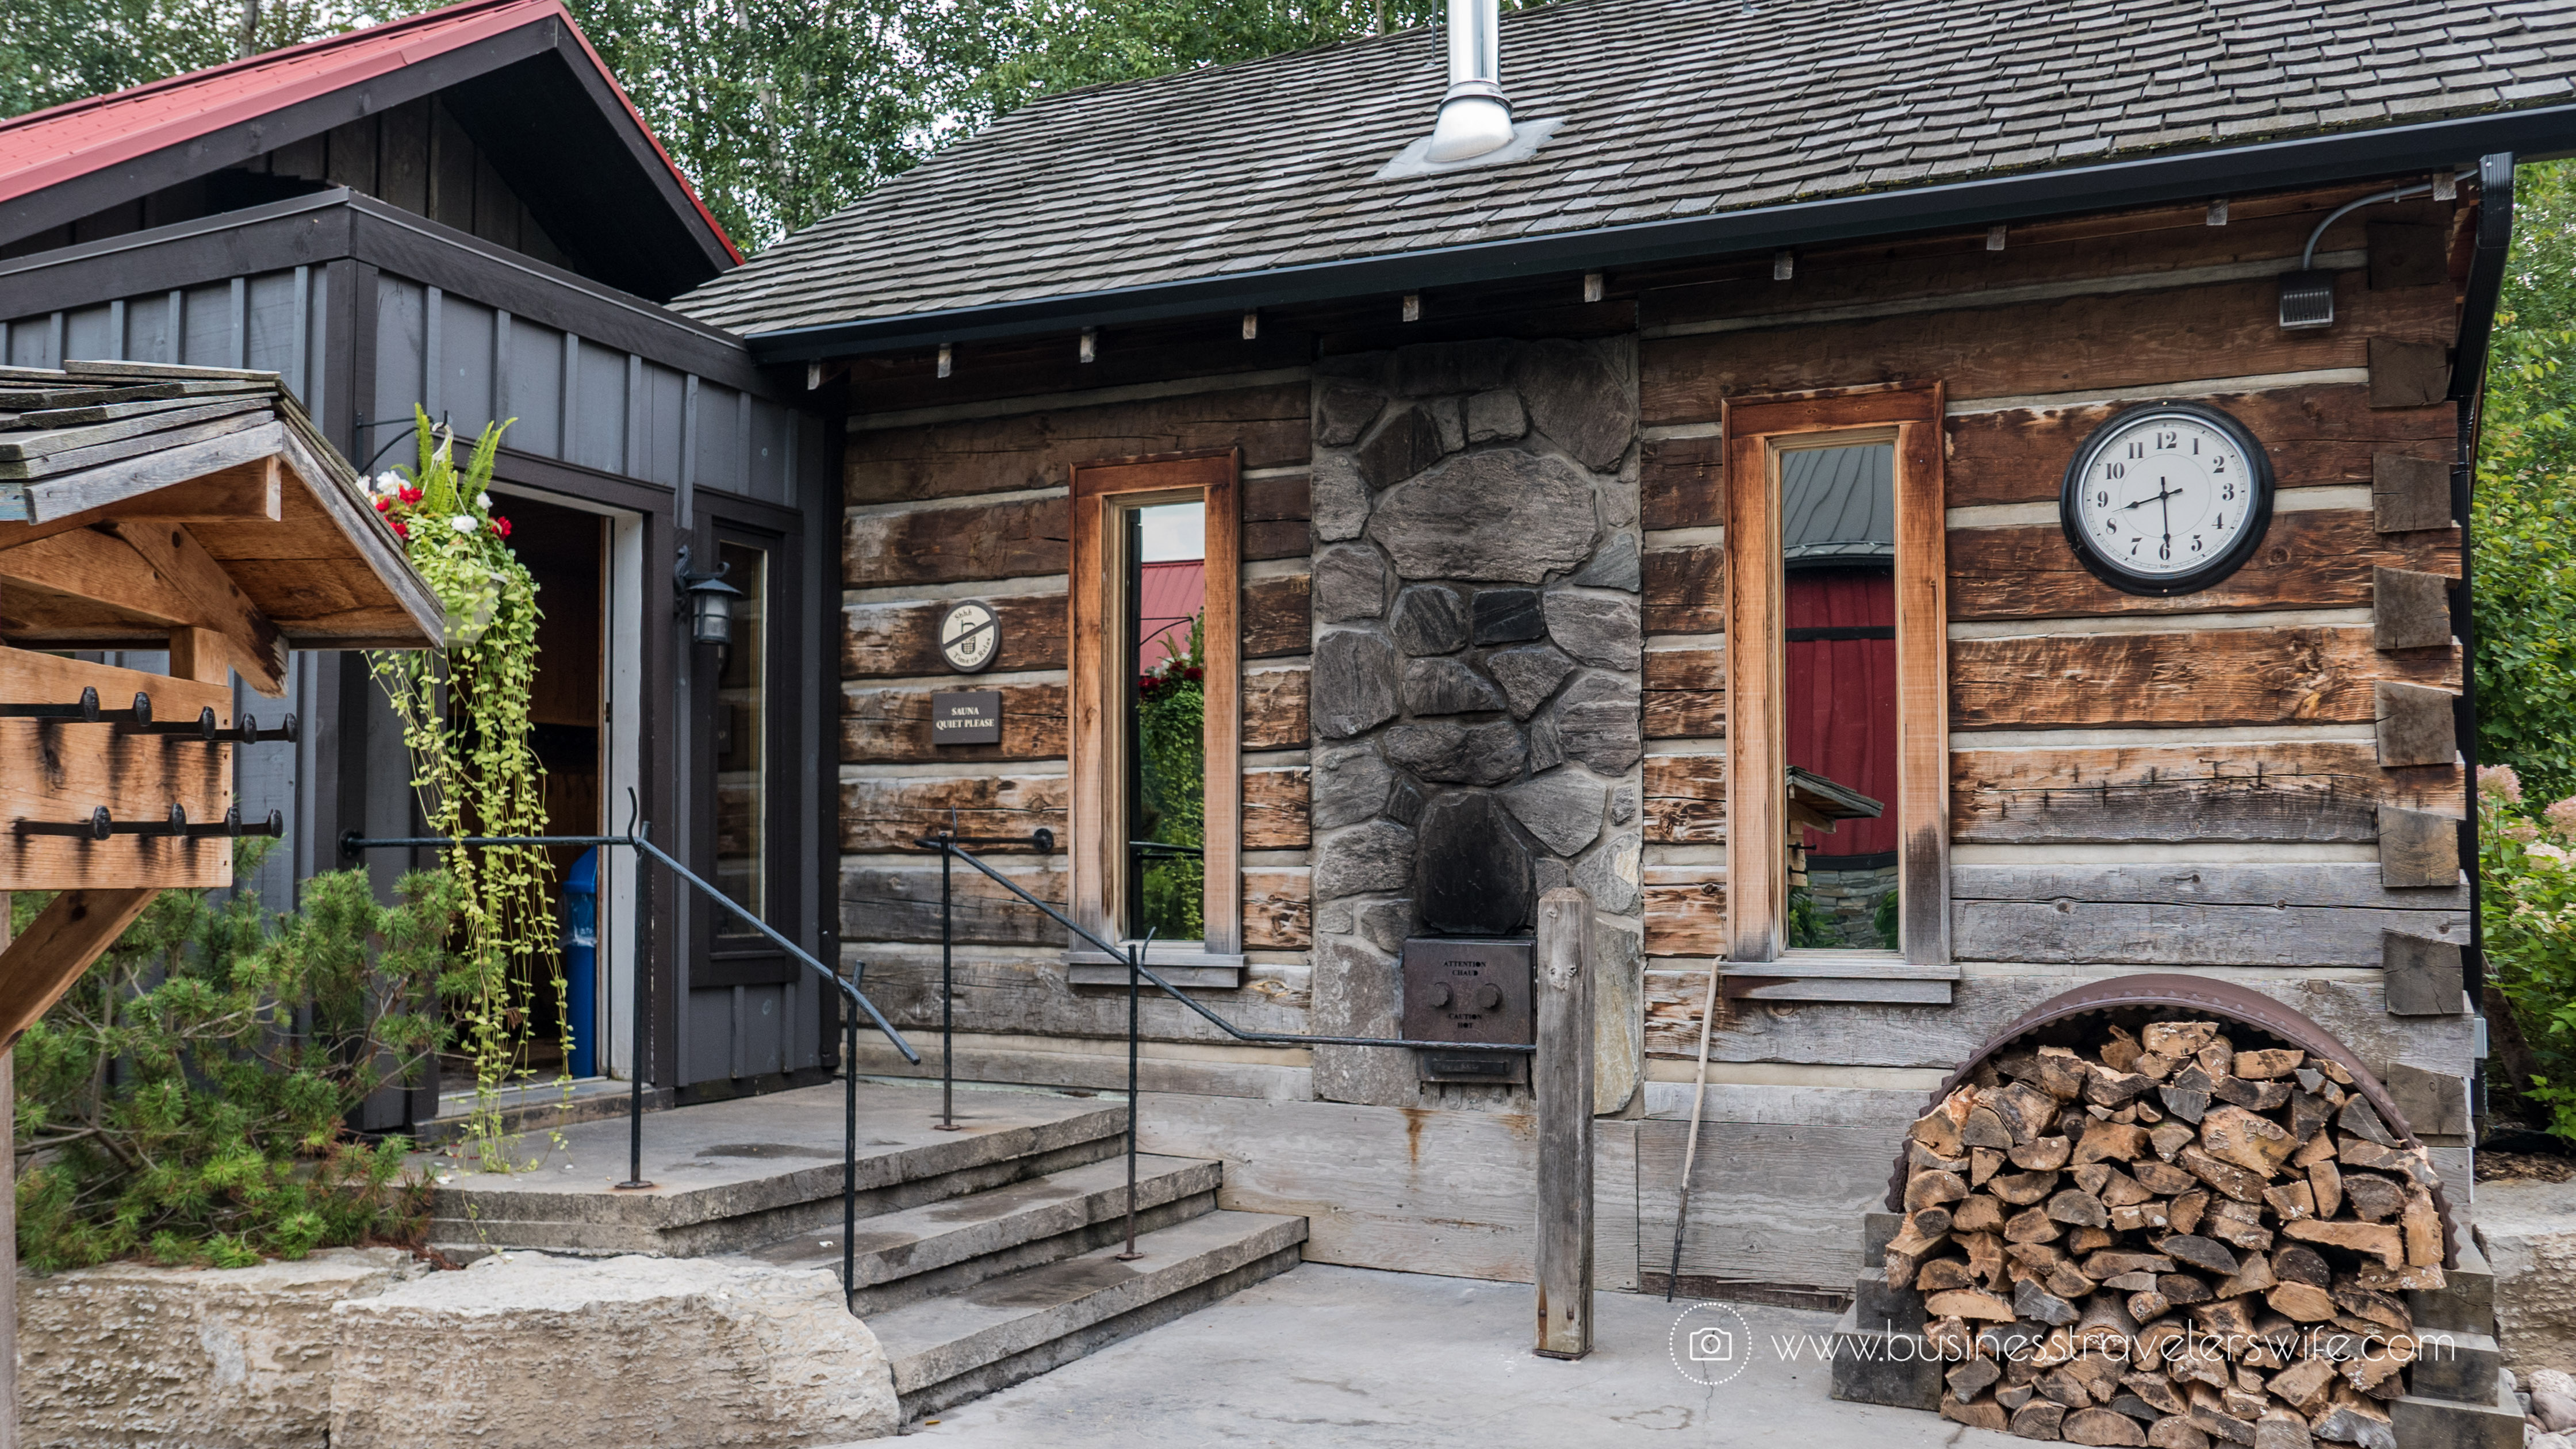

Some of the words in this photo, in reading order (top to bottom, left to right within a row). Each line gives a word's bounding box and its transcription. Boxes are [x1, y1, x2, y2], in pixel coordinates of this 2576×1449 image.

[2156, 431, 2178, 450] 12
[2191, 438, 2199, 455] 1
[2128, 442, 2144, 459] 11
[2105, 462, 2125, 480] 10
[2212, 455, 2225, 474] 2
[2097, 490, 2109, 508] 9
[2222, 482, 2234, 501] 3
[2106, 518, 2117, 535] 8
[2211, 512, 2225, 530] 4
[2130, 537, 2143, 555] 7
[2159, 542, 2171, 561] 6
[2191, 535, 2202, 551] 5
[953, 651, 970, 664] Time
[978, 637, 991, 658] Relax
[951, 707, 979, 716] SAUNA
[936, 720, 963, 730] QUIET
[964, 719, 995, 729] PLEASE
